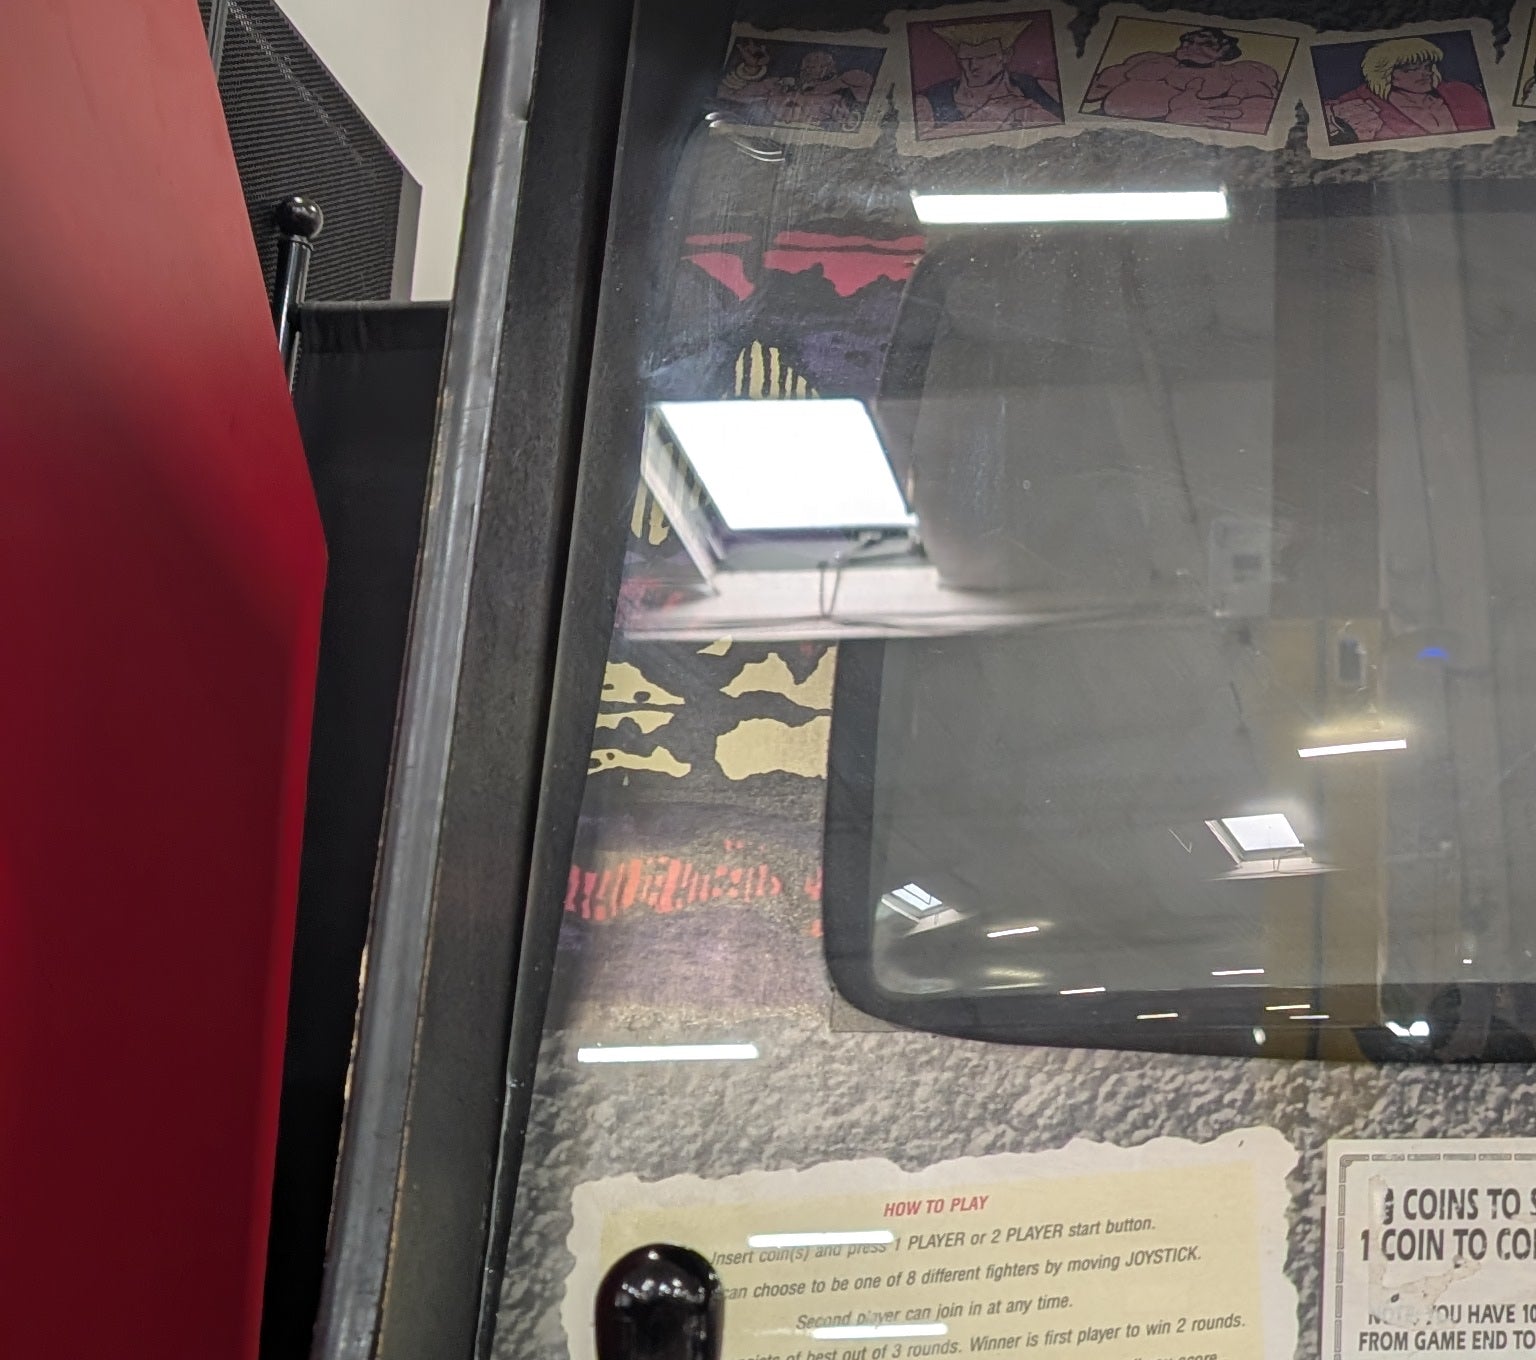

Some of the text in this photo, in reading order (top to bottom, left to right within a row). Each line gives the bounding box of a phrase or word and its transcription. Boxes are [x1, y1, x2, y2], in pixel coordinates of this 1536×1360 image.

[883, 1195, 989, 1218] HOW TO PLAY
[1403, 1187, 1479, 1221] COINS
[1487, 1187, 1521, 1220] TO
[815, 1243, 841, 1258] and
[895, 1235, 900, 1250] 1
[907, 1231, 965, 1250] PLAYER
[970, 1232, 986, 1245] or
[991, 1229, 1002, 1244] 2
[1005, 1224, 1063, 1242] PLAYER
[1068, 1220, 1101, 1238] start
[1105, 1217, 1156, 1234] button.
[1361, 1228, 1370, 1261] 1
[1382, 1227, 1444, 1261] COIN
[1454, 1227, 1487, 1260] TO
[753, 1281, 806, 1299] choose
[811, 1278, 826, 1293] to
[831, 1276, 850, 1291] be
[854, 1276, 881, 1291] one
[886, 1271, 903, 1287] of
[906, 1271, 916, 1285] 8
[921, 1265, 981, 1285] different
[985, 1261, 1040, 1281] fighters
[1045, 1259, 1062, 1277] by
[1067, 1254, 1120, 1273] moving
[1125, 1245, 1201, 1268] JOYSTICK.
[795, 1310, 852, 1330] Second
[905, 1304, 931, 1321] can
[936, 1300, 963, 1321] join
[968, 1300, 983, 1316] in
[987, 1299, 1002, 1315] at
[1005, 1298, 1032, 1316] any
[1037, 1294, 1074, 1310] time.
[1468, 1304, 1516, 1324] HAVE
[872, 1344, 888, 1360] of
[891, 1343, 902, 1359] 3
[907, 1340, 962, 1358] rounds.
[969, 1335, 1022, 1354] Winner
[1026, 1331, 1039, 1347] is
[1044, 1327, 1072, 1346] first
[1077, 1325, 1122, 1346] player
[1126, 1323, 1141, 1339] to
[1145, 1320, 1171, 1336] win
[1176, 1318, 1187, 1333] 2
[1191, 1313, 1247, 1332] rounds.
[1359, 1331, 1409, 1351] FROM
[1415, 1330, 1467, 1351] GAME
[1472, 1330, 1507, 1350] END
